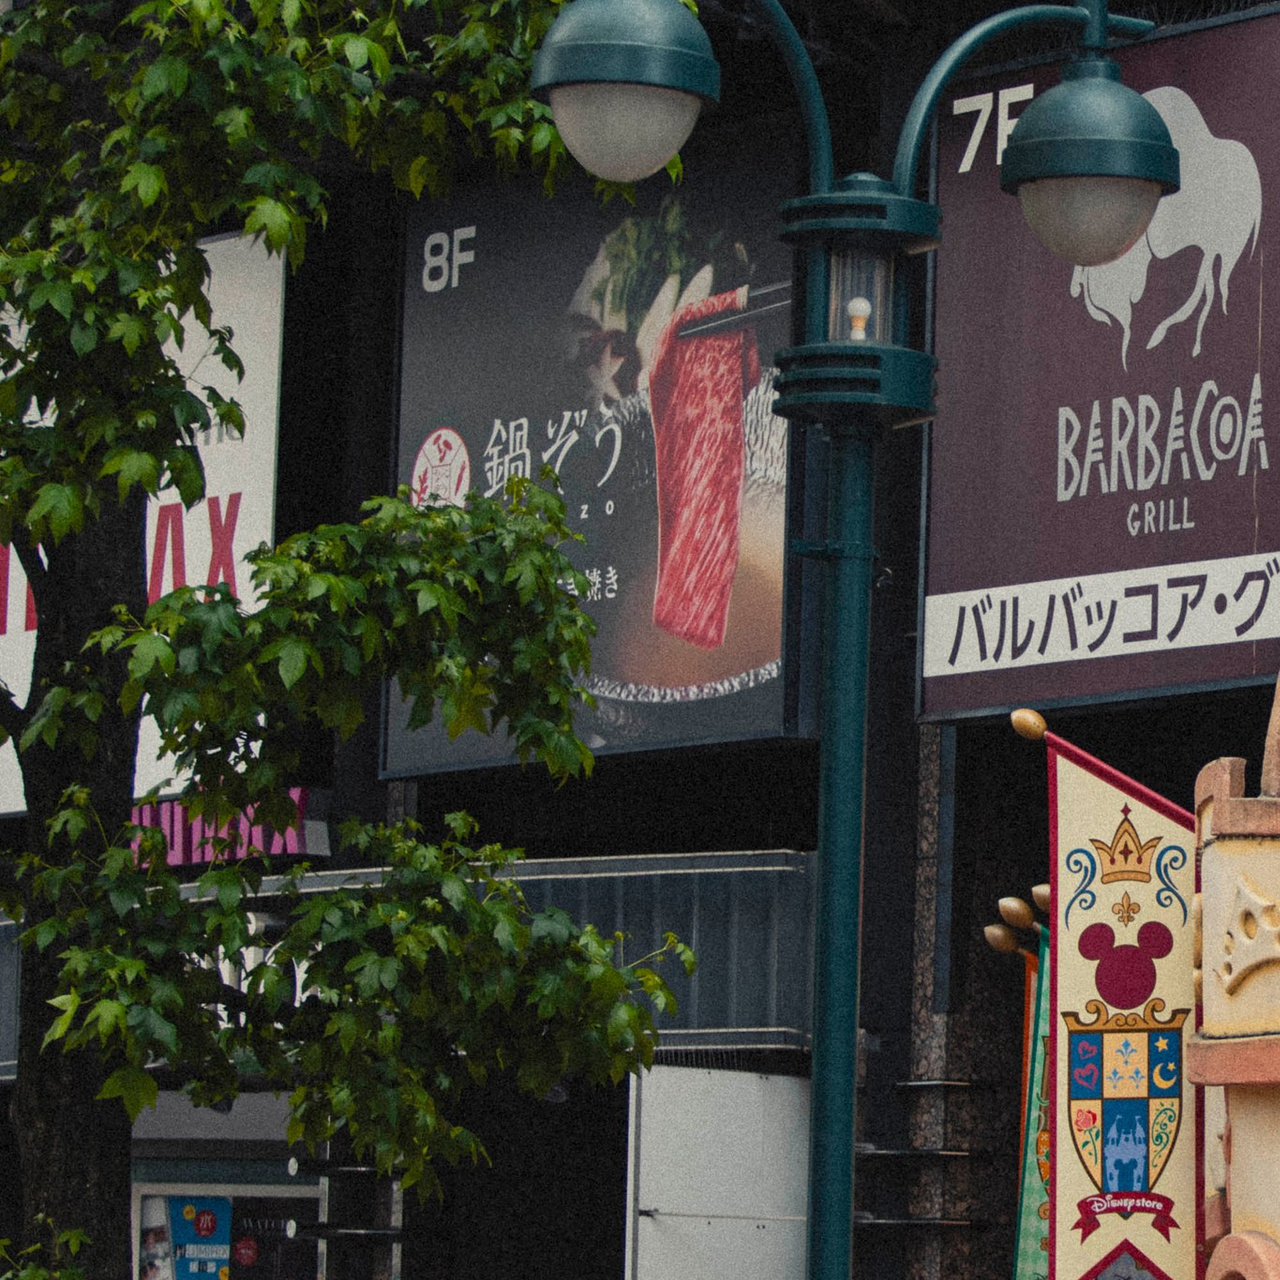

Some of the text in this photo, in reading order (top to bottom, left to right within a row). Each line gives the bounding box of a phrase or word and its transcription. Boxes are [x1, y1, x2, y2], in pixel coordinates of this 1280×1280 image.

[952, 82, 1035, 174] 7F
[421, 224, 478, 294] 8F
[1056, 372, 1270, 503] BARBACOA
[1126, 497, 1196, 537] GRILL
